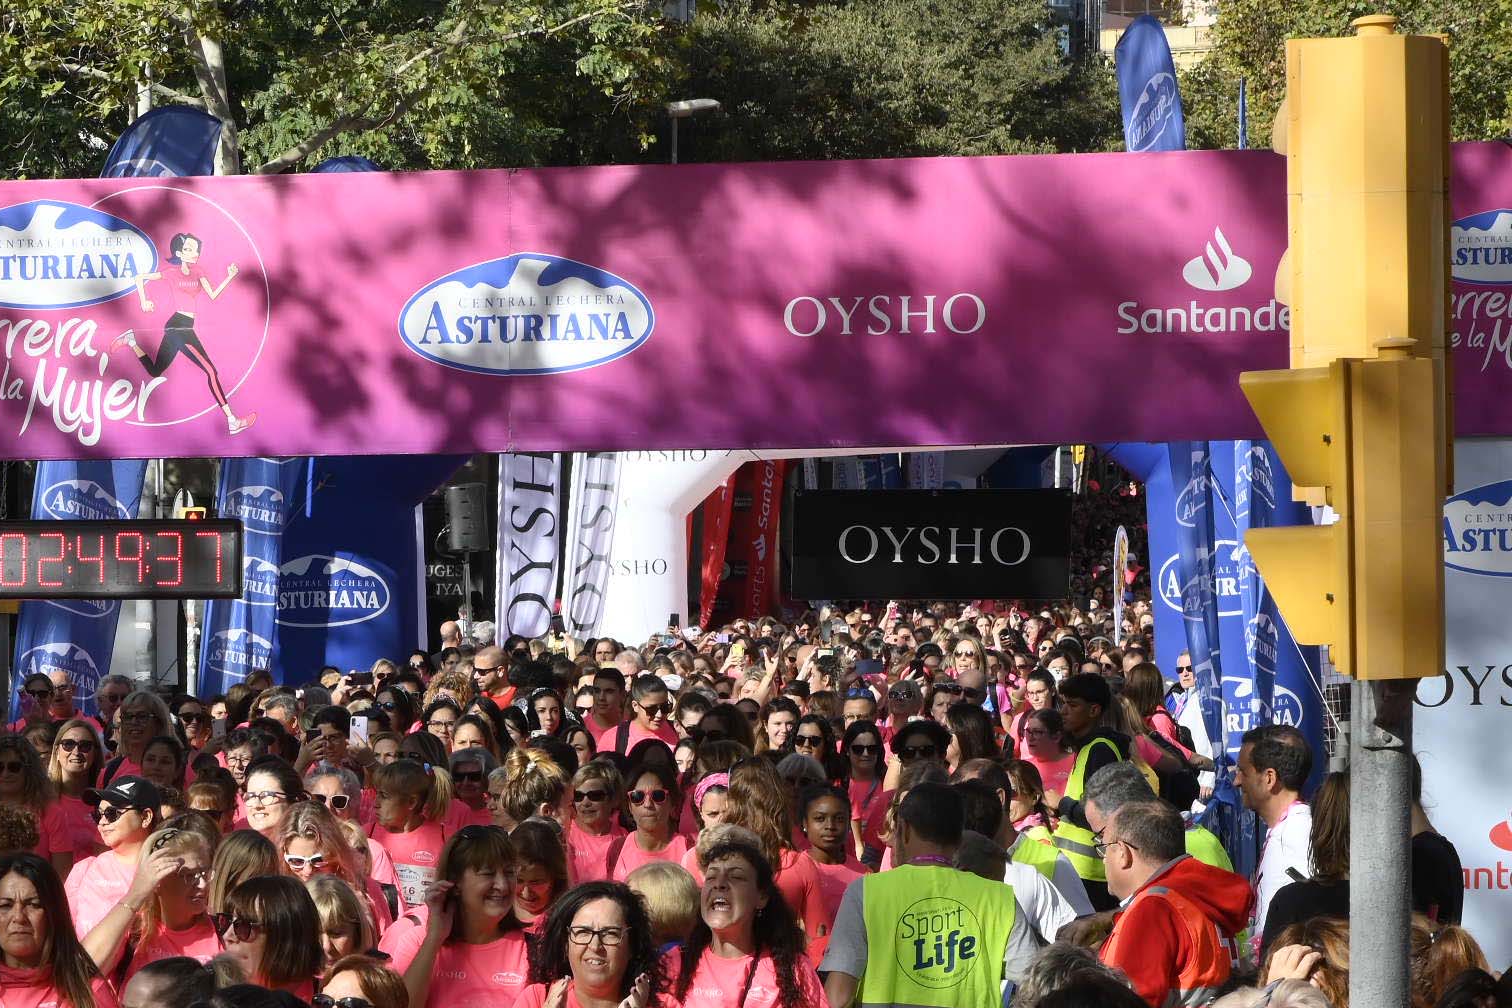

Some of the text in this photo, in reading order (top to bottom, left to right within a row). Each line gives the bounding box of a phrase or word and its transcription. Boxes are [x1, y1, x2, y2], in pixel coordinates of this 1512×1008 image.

[61, 236, 133, 249] LECHERA
[458, 294, 626, 308] CENTRAL LECHERA
[783, 293, 986, 337] OYSHO
[418, 300, 634, 346] ASTURIANA
[0, 361, 24, 401] la
[19, 353, 168, 447] Mujer
[0, 532, 223, 587] 02:49:37
[838, 525, 1031, 566] OYSHO
[277, 590, 381, 609] STURIANA
[902, 905, 964, 940] Sport
[913, 930, 976, 973] Life
